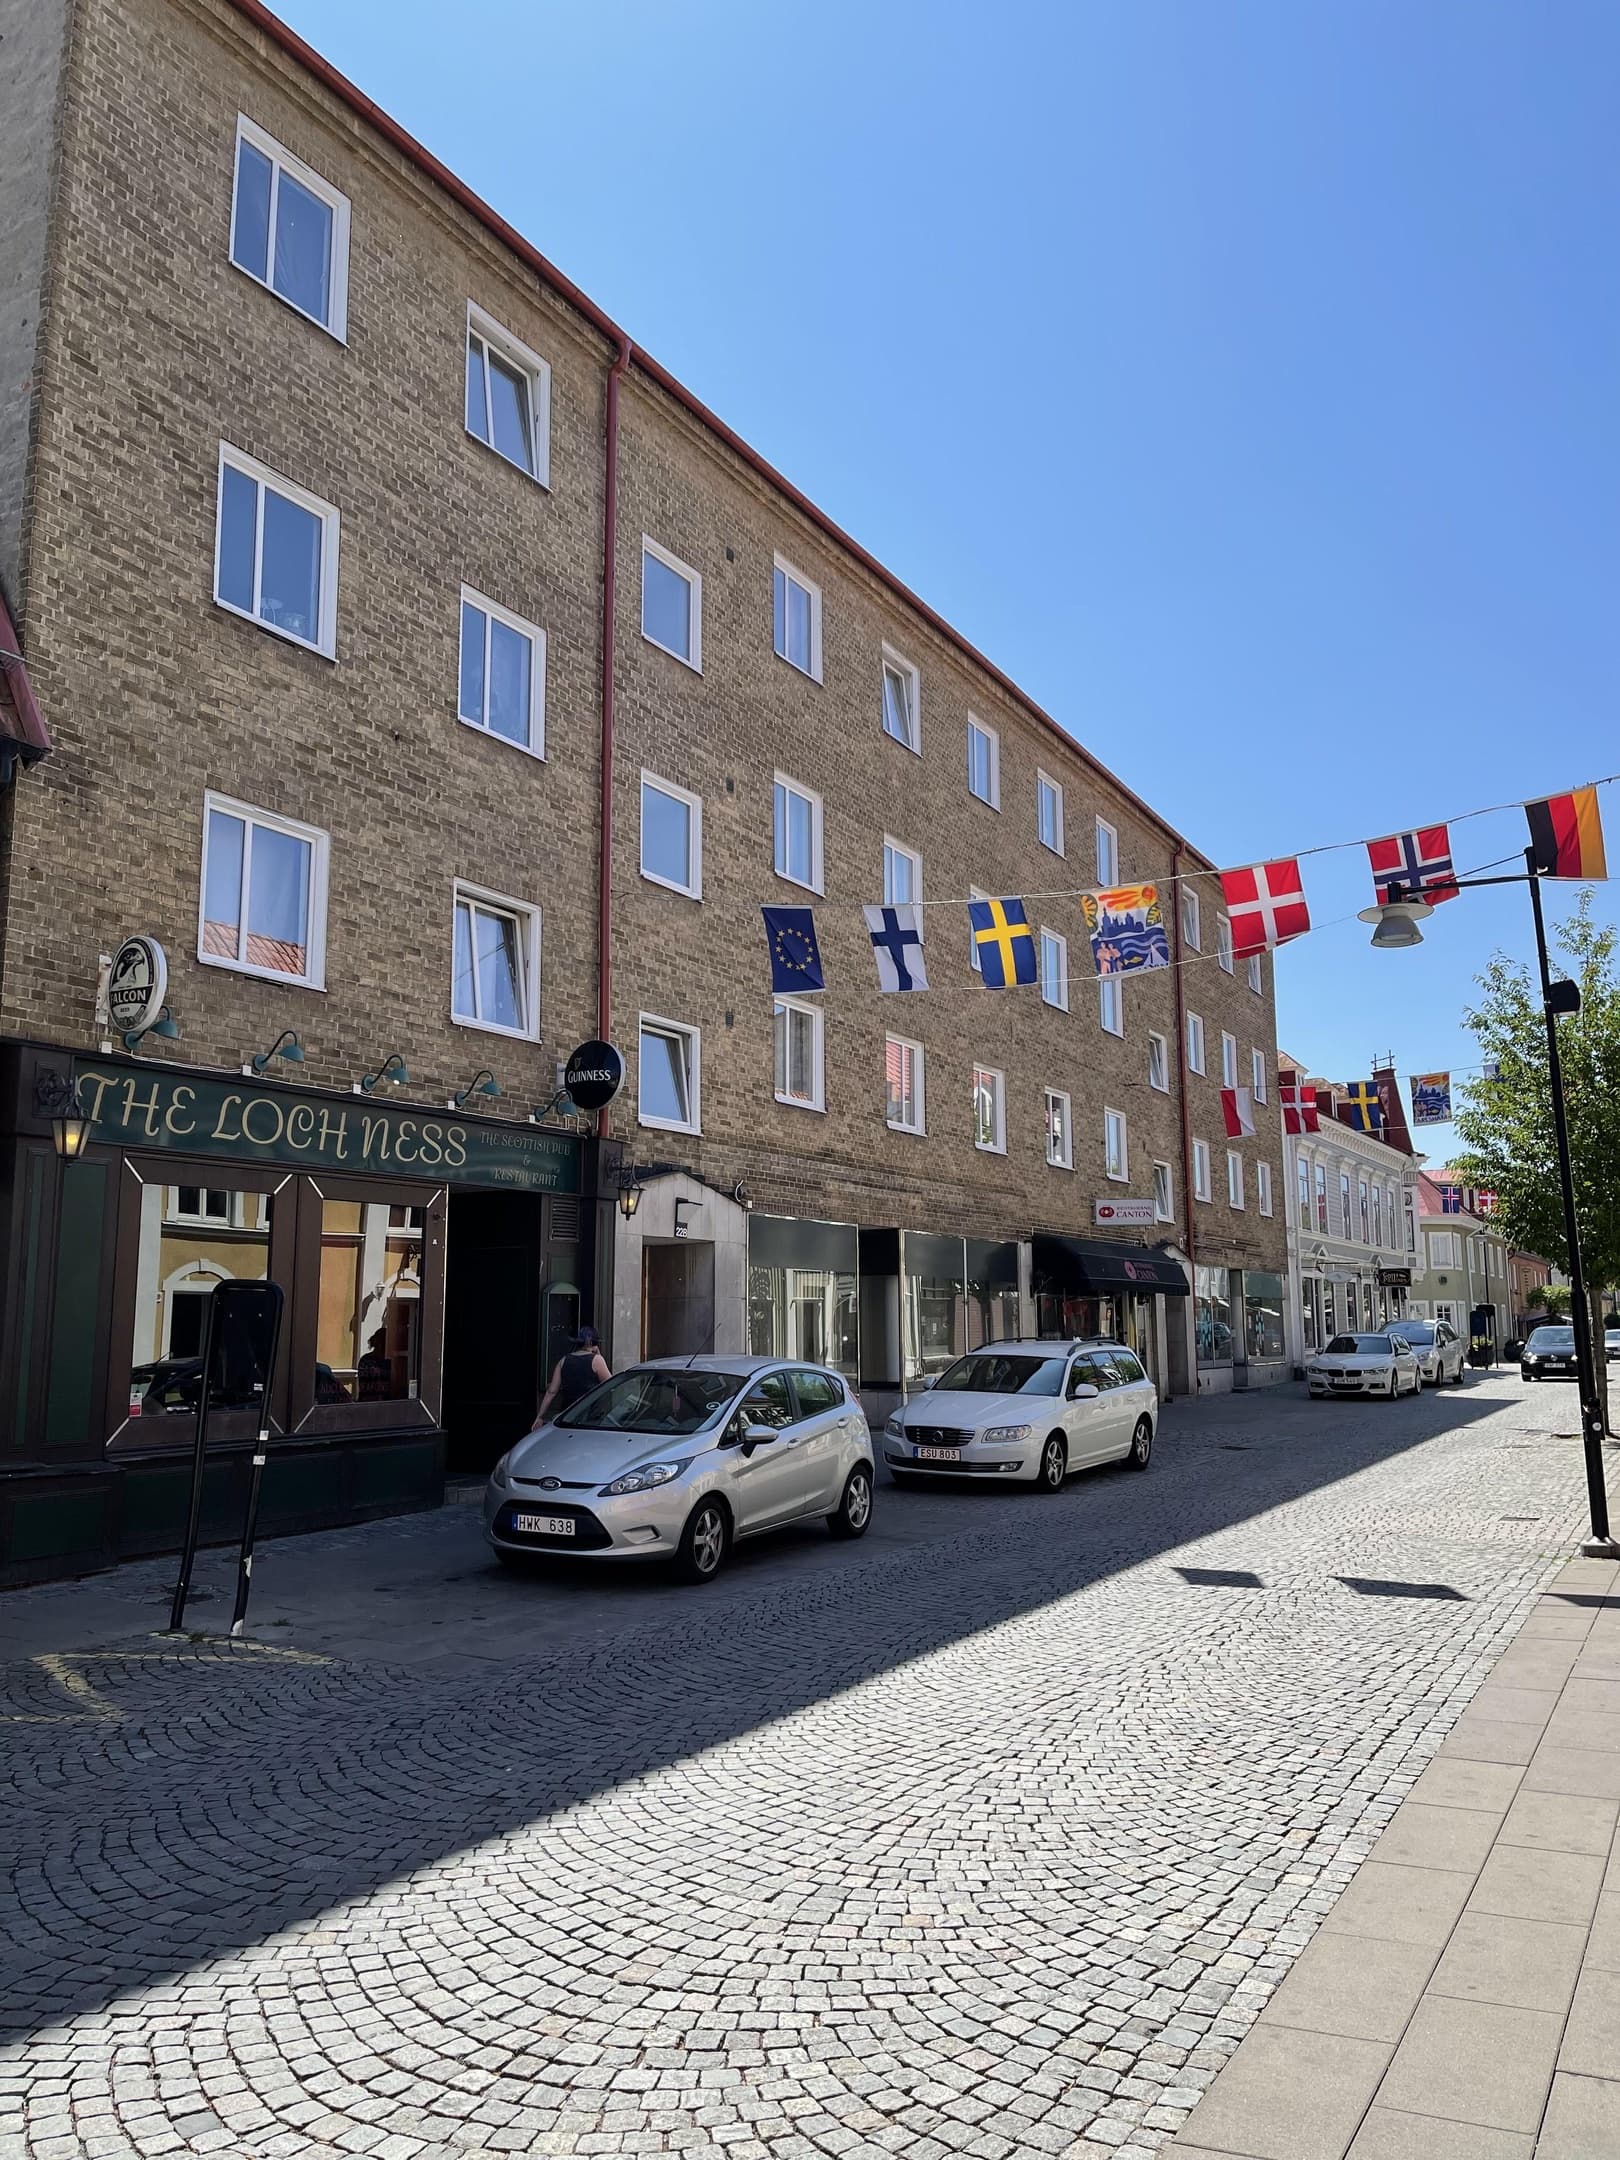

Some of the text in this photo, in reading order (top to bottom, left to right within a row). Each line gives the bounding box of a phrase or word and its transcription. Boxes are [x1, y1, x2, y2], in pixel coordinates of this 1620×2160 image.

[110, 989, 146, 1005] FALCON
[567, 1069, 611, 1084] GUINNESS
[75, 1071, 467, 1167] THE LOCH NESS
[480, 1130, 501, 1147] THE
[501, 1134, 550, 1155] SCOTTISH
[494, 1167, 558, 1187] RESTAURANT
[1116, 1210, 1153, 1218] CANTON
[920, 1449, 957, 1460] ESU 803
[519, 1516, 573, 1534] HWK 638
